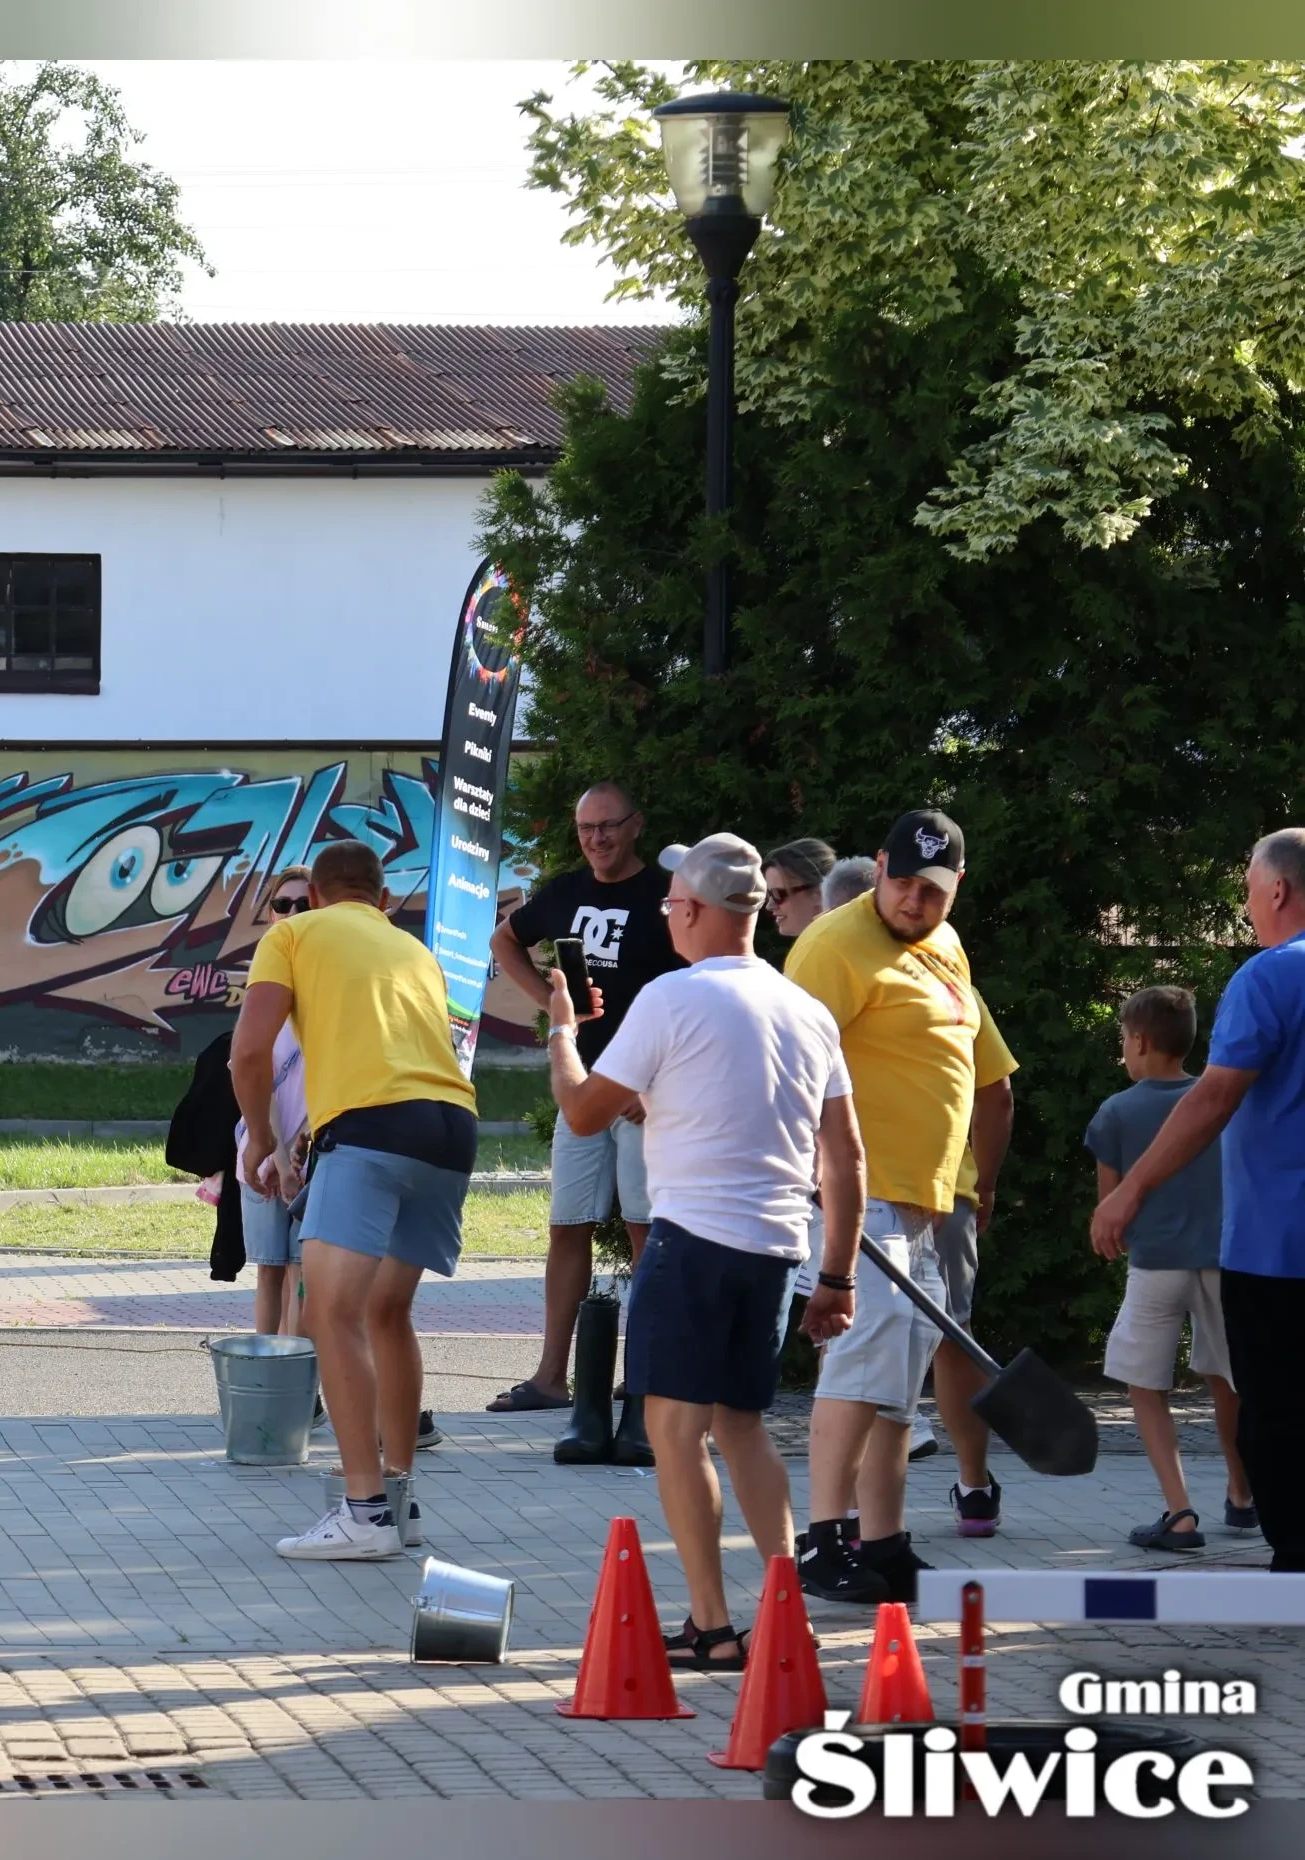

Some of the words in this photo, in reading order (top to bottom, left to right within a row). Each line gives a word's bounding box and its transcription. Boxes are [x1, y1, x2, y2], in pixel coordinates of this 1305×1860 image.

[468, 702, 497, 727] Eventy
[464, 740, 493, 763] Pikniki
[453, 775, 494, 806] Warsztaty
[453, 797, 468, 813] dla
[468, 802, 491, 822] dzieci
[451, 834, 490, 862] Urodziny
[448, 873, 490, 900] Animacje
